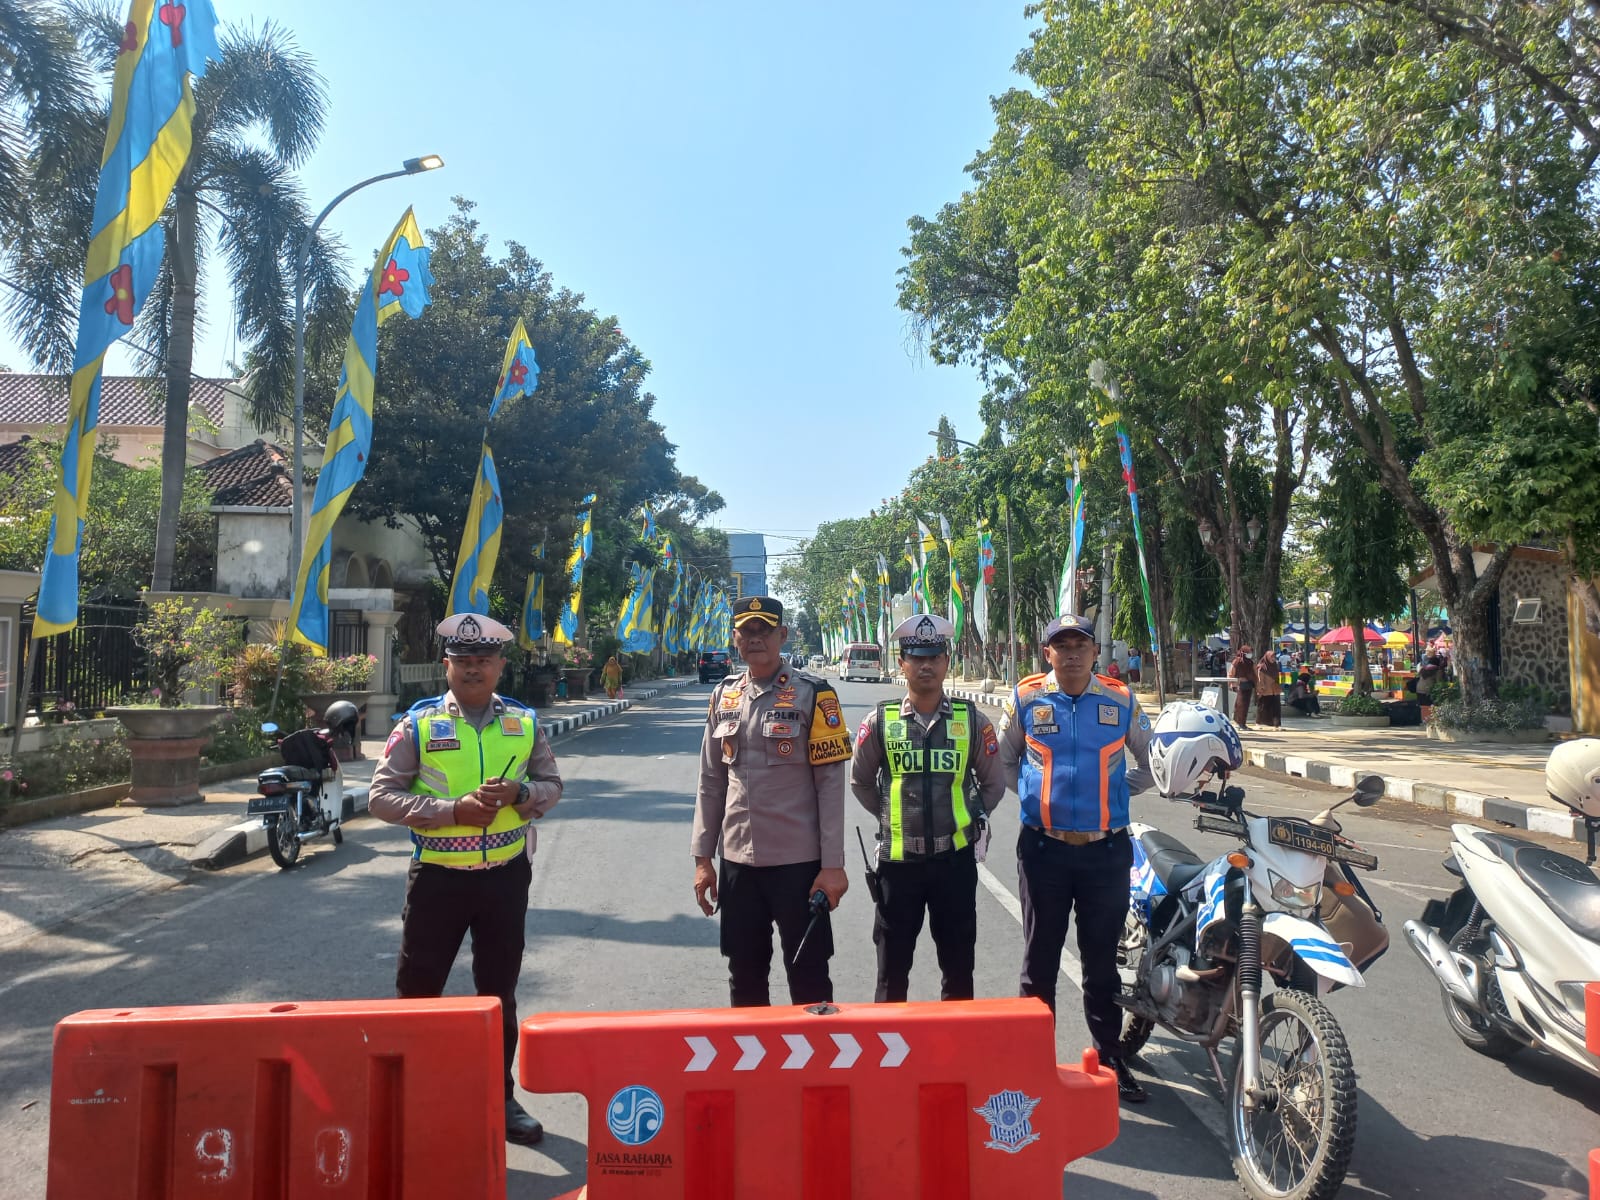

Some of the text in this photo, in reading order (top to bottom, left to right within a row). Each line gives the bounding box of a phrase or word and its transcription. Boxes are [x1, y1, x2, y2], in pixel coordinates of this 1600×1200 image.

[766, 711, 799, 721] POLRI
[810, 739, 841, 753] PADAL
[887, 740, 911, 750] LUKY
[811, 748, 844, 761] LAMONGAN
[1295, 836, 1332, 854] 1194-60
[595, 1152, 672, 1166] JASA RAHARJA
